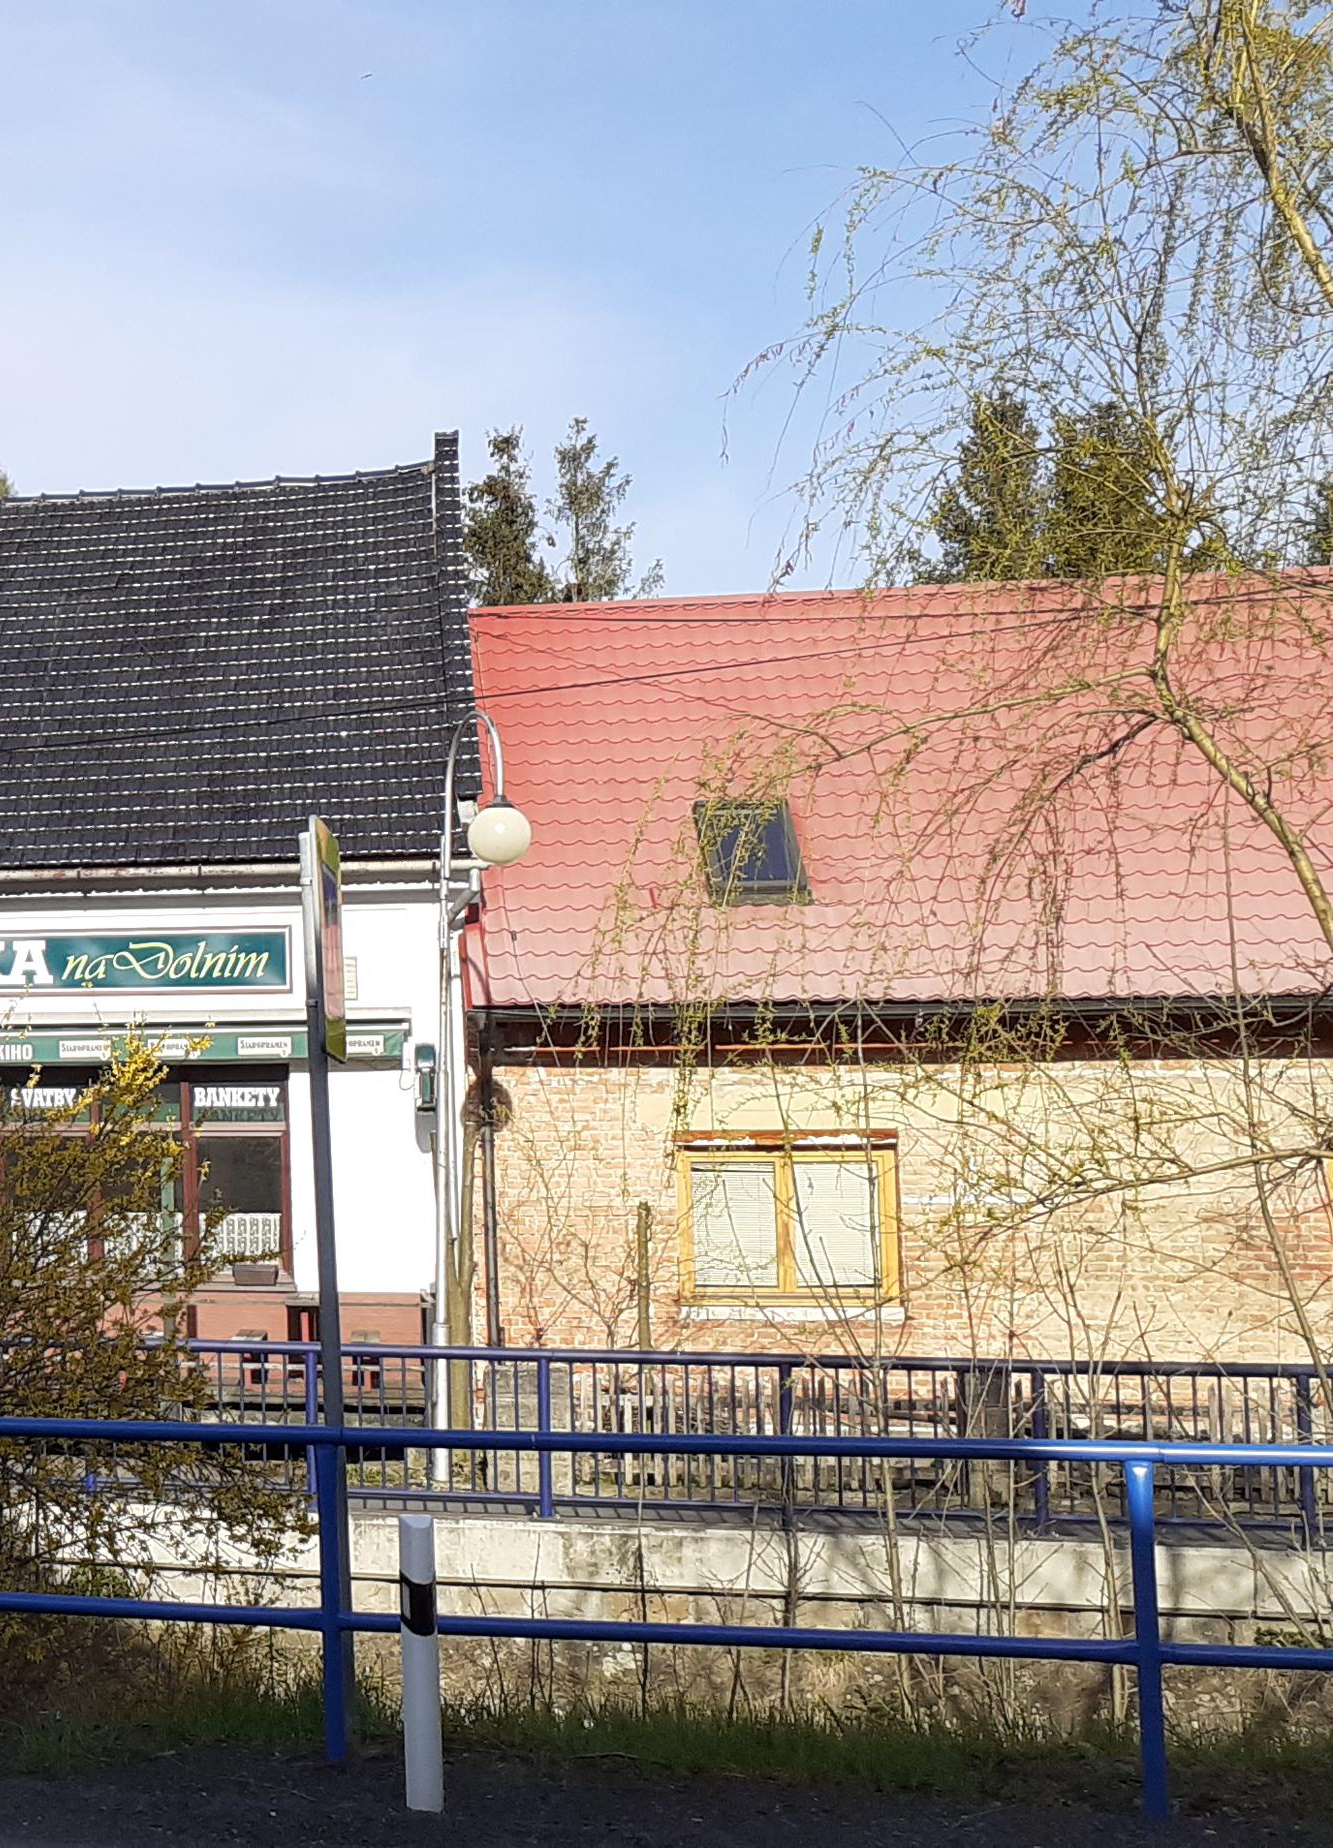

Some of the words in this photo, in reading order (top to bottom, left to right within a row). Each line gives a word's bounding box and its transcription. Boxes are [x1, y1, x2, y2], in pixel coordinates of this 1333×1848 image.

[113, 941, 270, 980] Dolním
[10, 1087, 76, 1108] SVATBY
[194, 1086, 281, 1108] BANKETY
